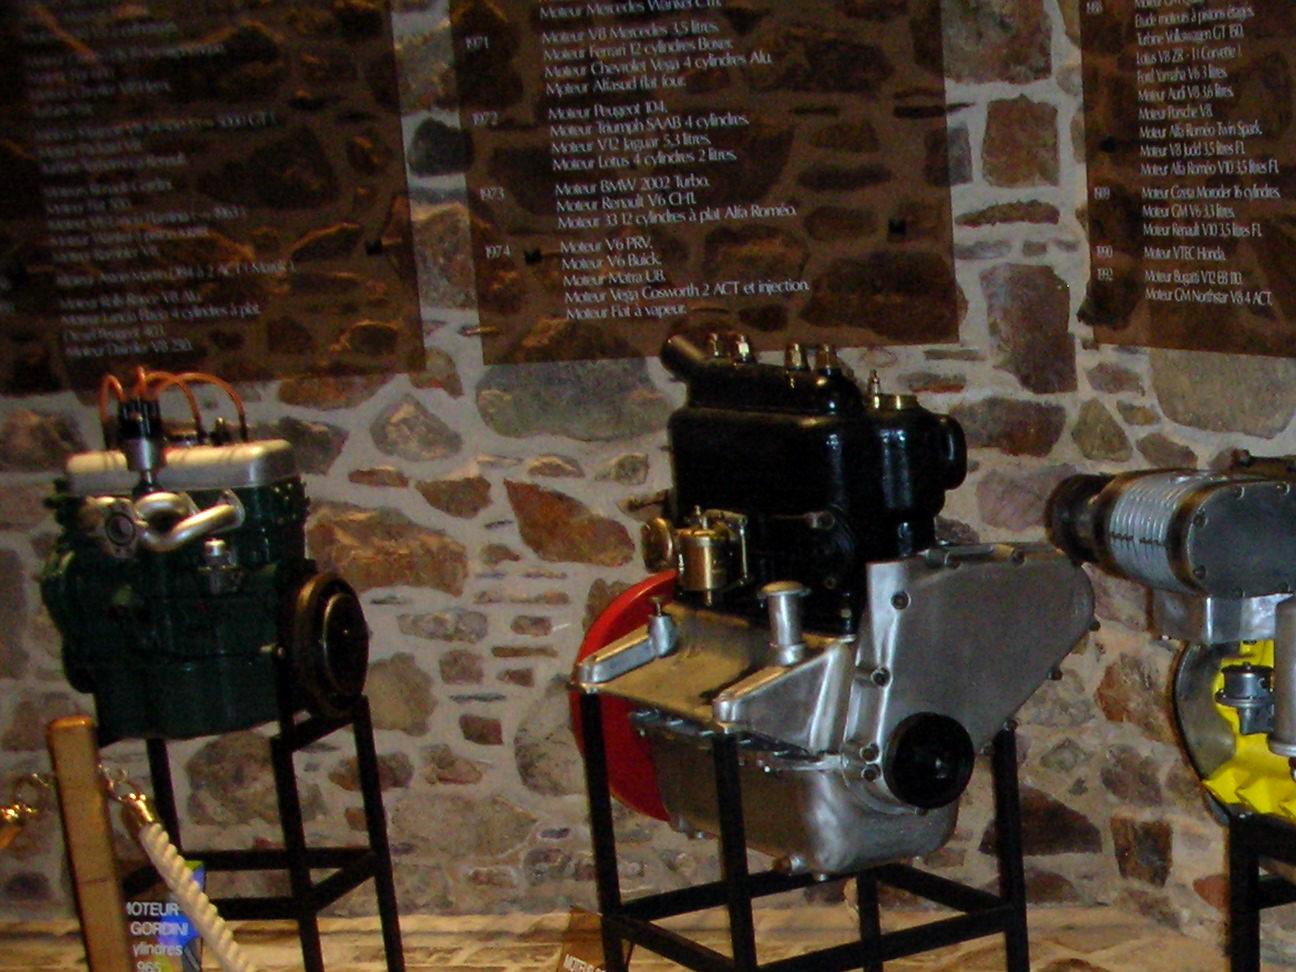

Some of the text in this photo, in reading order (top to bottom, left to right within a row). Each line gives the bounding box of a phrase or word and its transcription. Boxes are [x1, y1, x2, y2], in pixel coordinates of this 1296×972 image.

[542, 27, 584, 44] Moteur
[543, 44, 585, 61] Moteur
[548, 107, 590, 120] Moteur
[550, 124, 592, 137] Moteur
[551, 141, 593, 154] Moteur
[553, 159, 594, 171] Moteur
[555, 182, 597, 196] Moteur
[557, 199, 598, 212] Moteur
[558, 216, 600, 229] Moteur
[560, 239, 602, 253] Moteur
[562, 256, 603, 270] Moteur
[563, 272, 605, 286] Moteur
[565, 289, 606, 304] Moteur
[642, 281, 700, 300] Cosworth
[566, 306, 608, 320] Moteur
[130, 921, 188, 936] GORDINI
